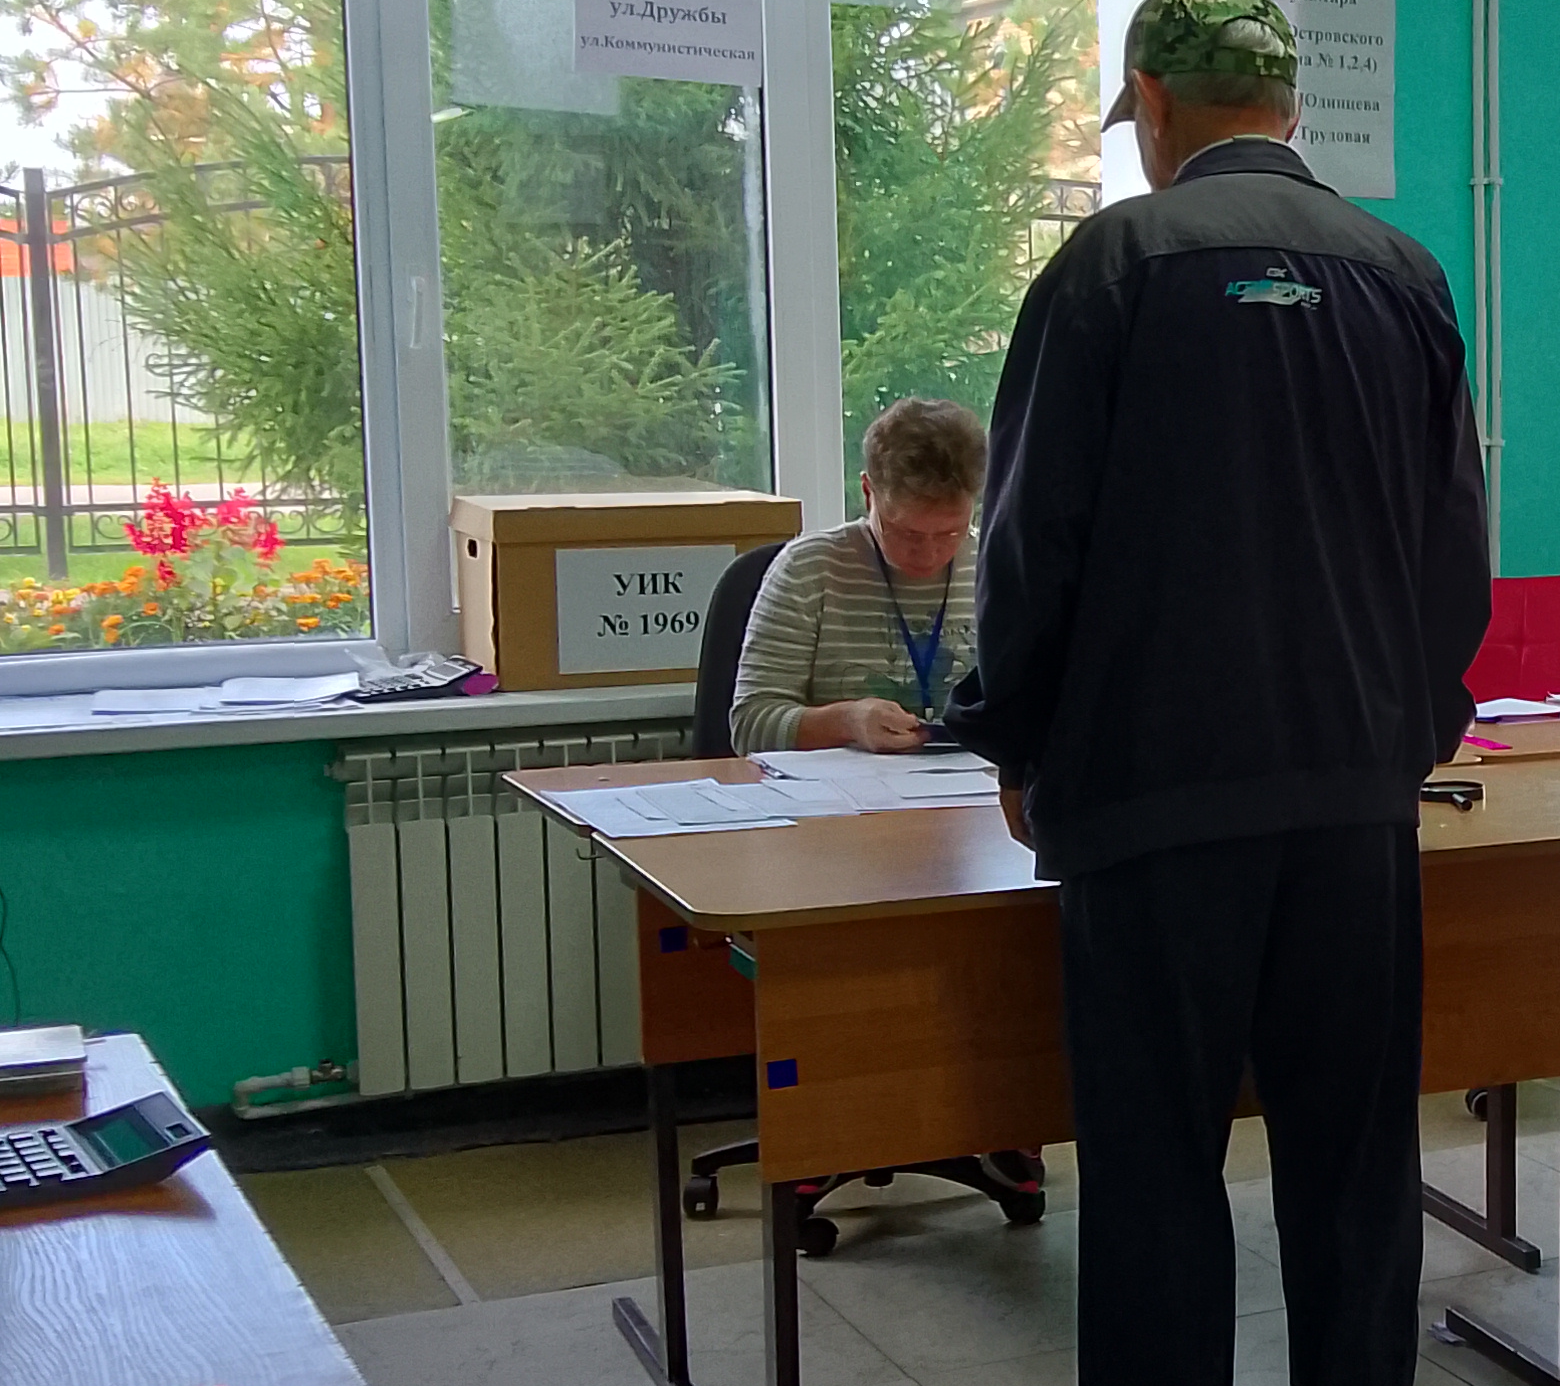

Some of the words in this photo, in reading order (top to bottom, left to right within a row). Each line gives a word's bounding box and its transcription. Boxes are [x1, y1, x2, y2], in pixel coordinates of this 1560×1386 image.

[609, 0, 728, 25] ул.Дружбы
[580, 34, 756, 61] ул.Коммунистическая
[612, 571, 684, 597] УИК
[597, 614, 630, 637] №
[640, 610, 700, 636] 1969
